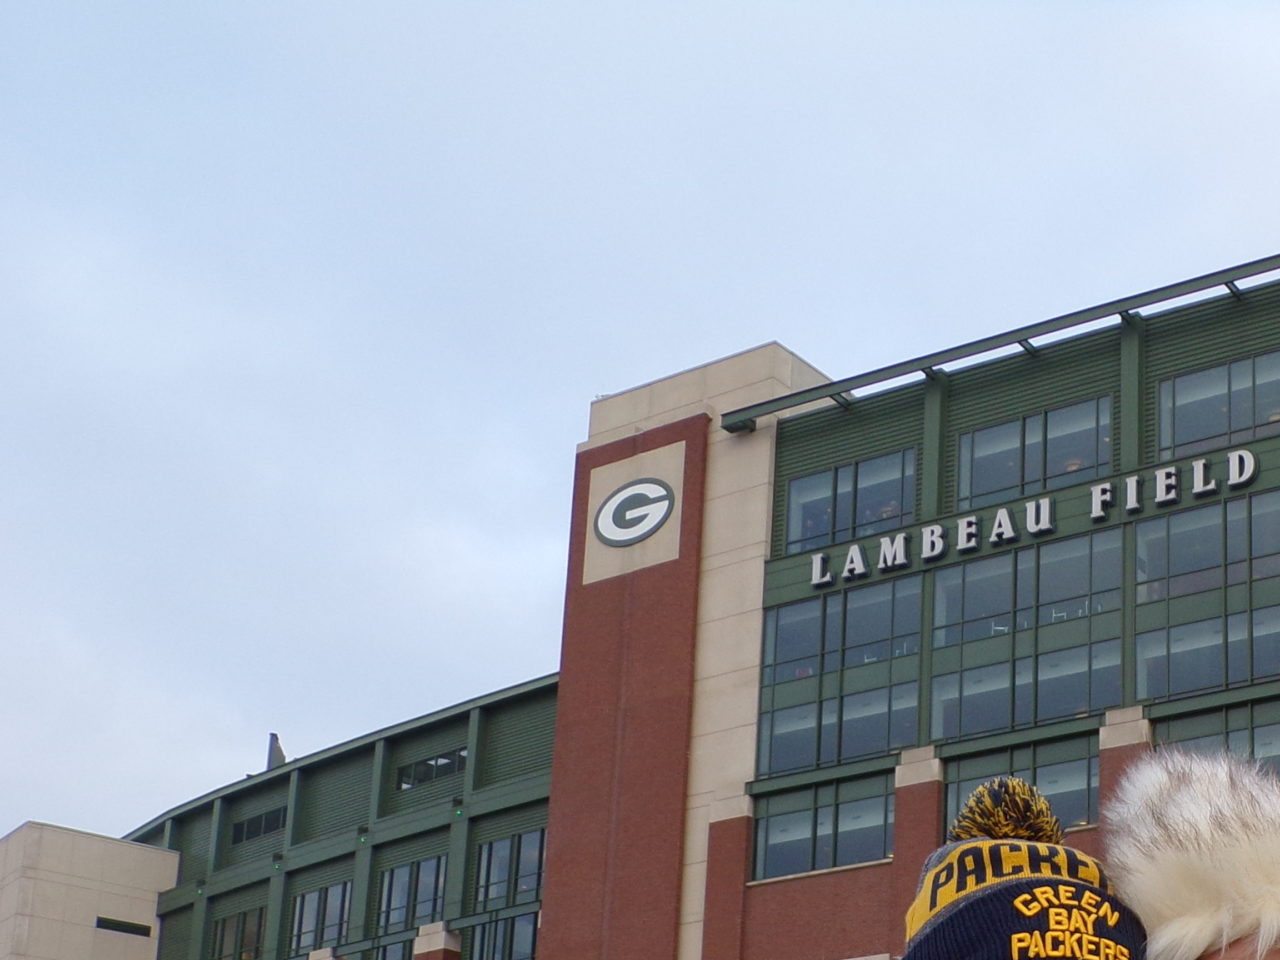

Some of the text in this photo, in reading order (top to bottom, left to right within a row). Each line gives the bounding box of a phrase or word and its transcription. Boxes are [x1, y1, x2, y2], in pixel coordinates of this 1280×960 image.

[596, 482, 671, 542] G
[811, 449, 1257, 587] LAMBEAU FIELD
[1013, 885, 1120, 927] GREEN
[1049, 908, 1097, 934] BAY
